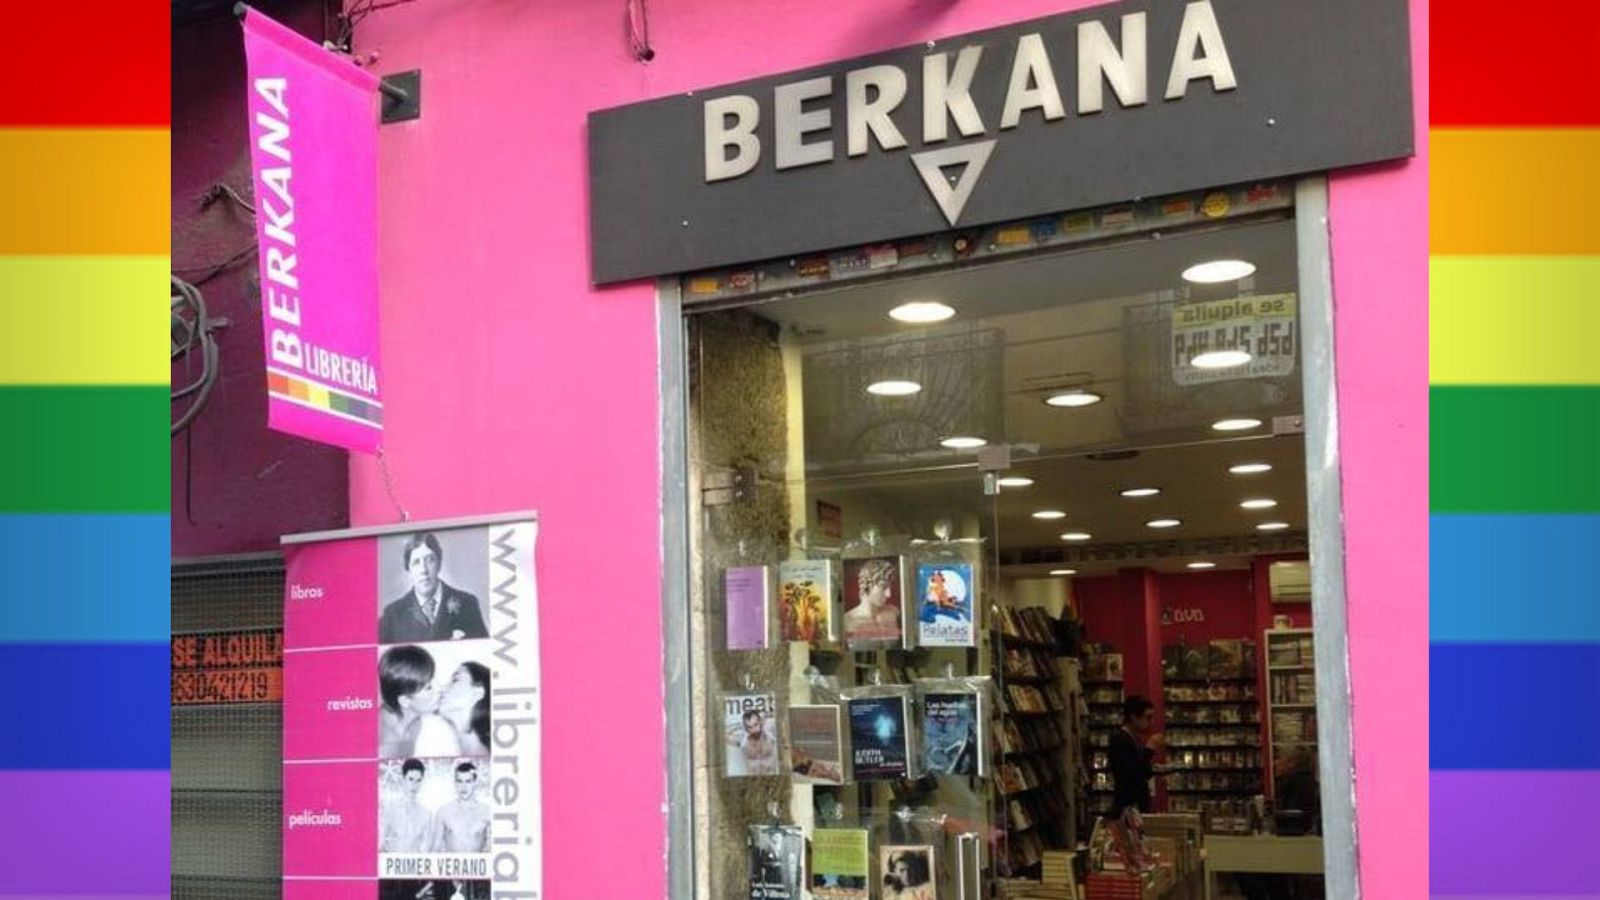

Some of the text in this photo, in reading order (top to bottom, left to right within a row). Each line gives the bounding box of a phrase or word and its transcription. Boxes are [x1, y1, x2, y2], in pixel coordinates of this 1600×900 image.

[704, 0, 1237, 182] BERKANA
[253, 77, 303, 369] BERKANA
[305, 342, 378, 395] LIBRERÍA
[290, 584, 324, 600] libros
[173, 637, 197, 666] SE
[327, 695, 374, 711] revistas
[725, 696, 775, 715] meat
[289, 808, 342, 830] películas
[386, 857, 488, 876] PRIMER VERANO
